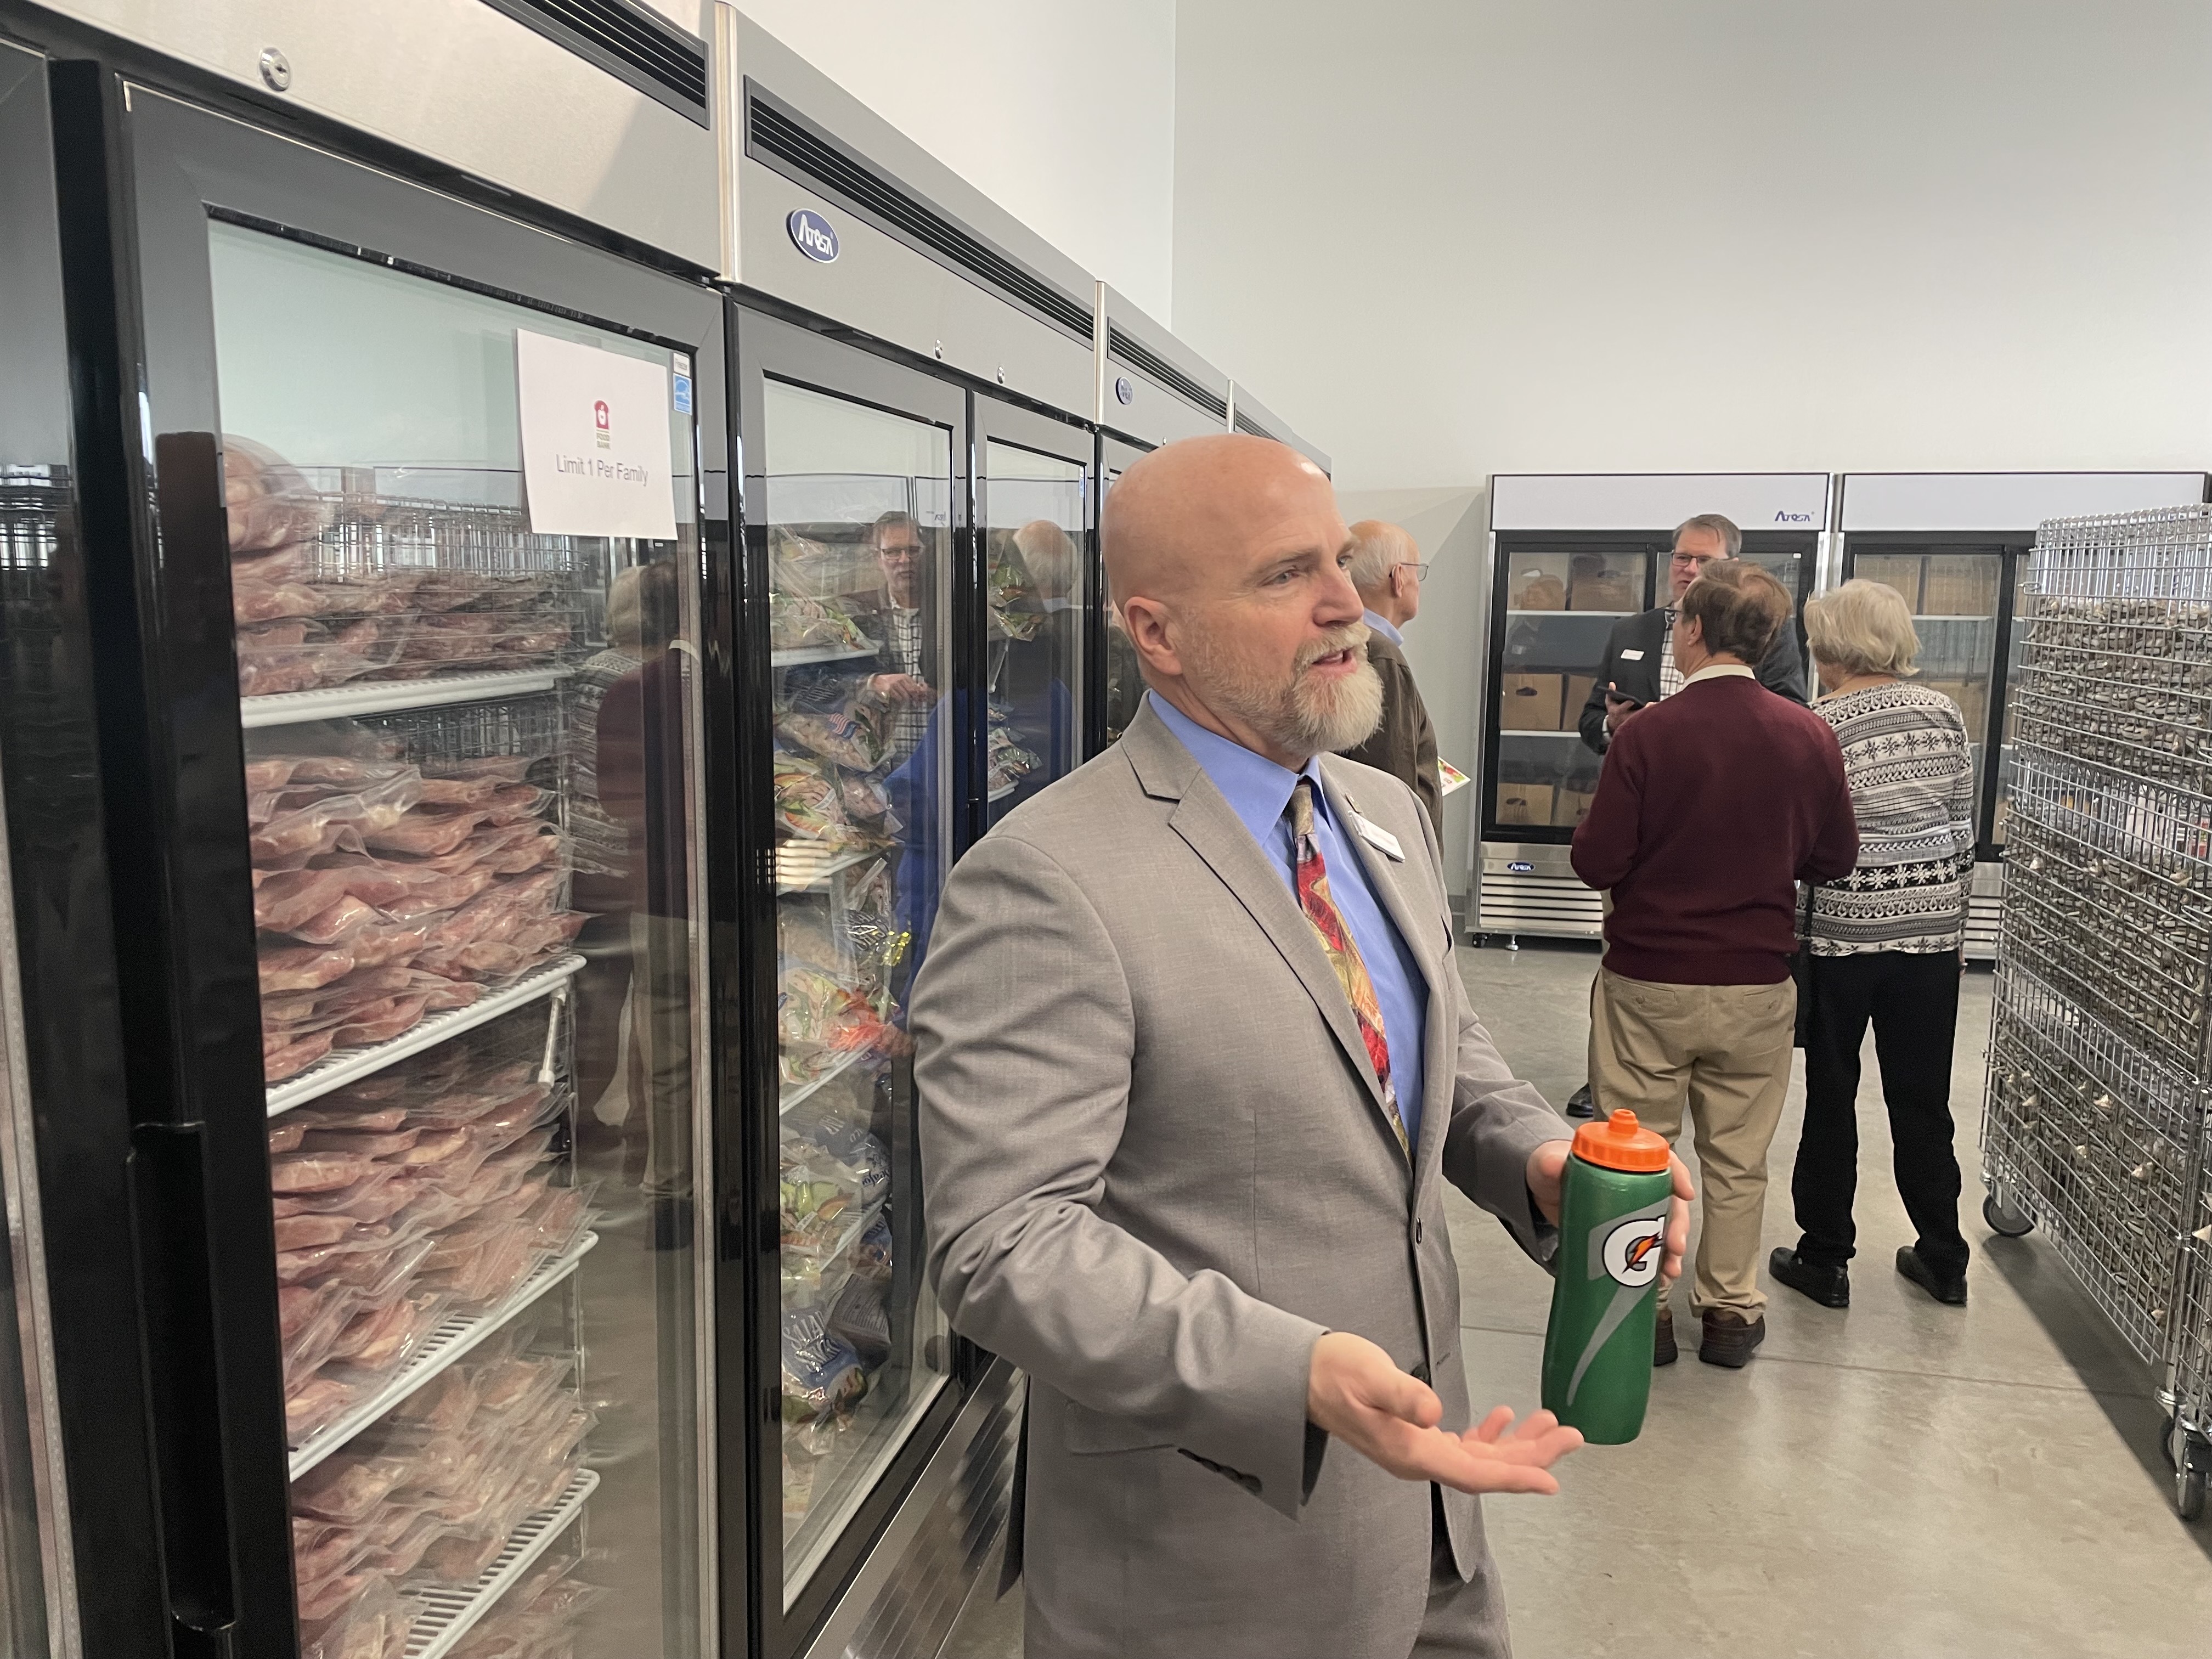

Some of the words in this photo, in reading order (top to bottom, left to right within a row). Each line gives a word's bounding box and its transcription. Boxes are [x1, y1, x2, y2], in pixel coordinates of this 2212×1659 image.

[556, 454, 585, 475] Limit
[588, 458, 594, 476] 1
[597, 459, 613, 479] Per
[616, 462, 648, 487] Family
